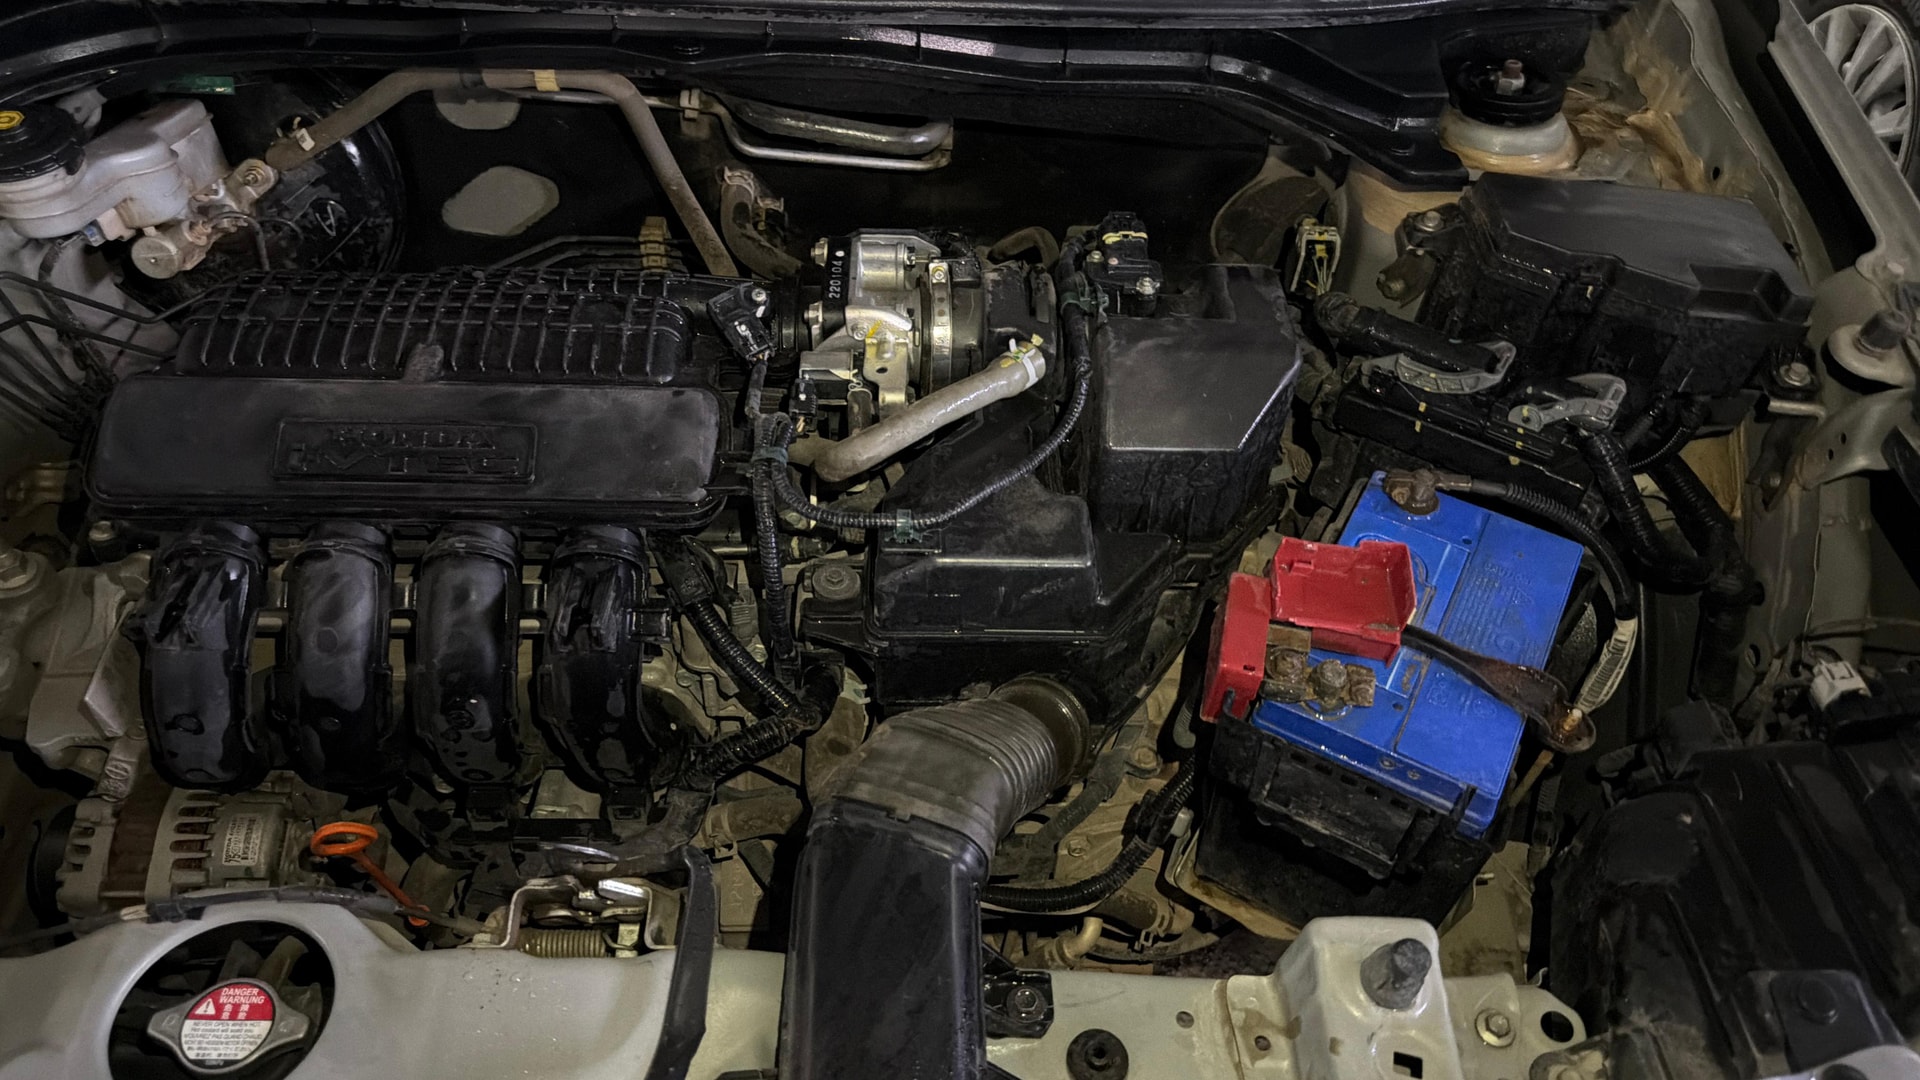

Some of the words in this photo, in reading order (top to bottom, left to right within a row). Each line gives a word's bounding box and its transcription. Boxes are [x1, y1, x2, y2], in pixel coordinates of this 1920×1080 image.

[828, 260, 843, 299] 220104
[221, 987, 259, 995] DANGER
[219, 995, 265, 1004] WARNUNG
